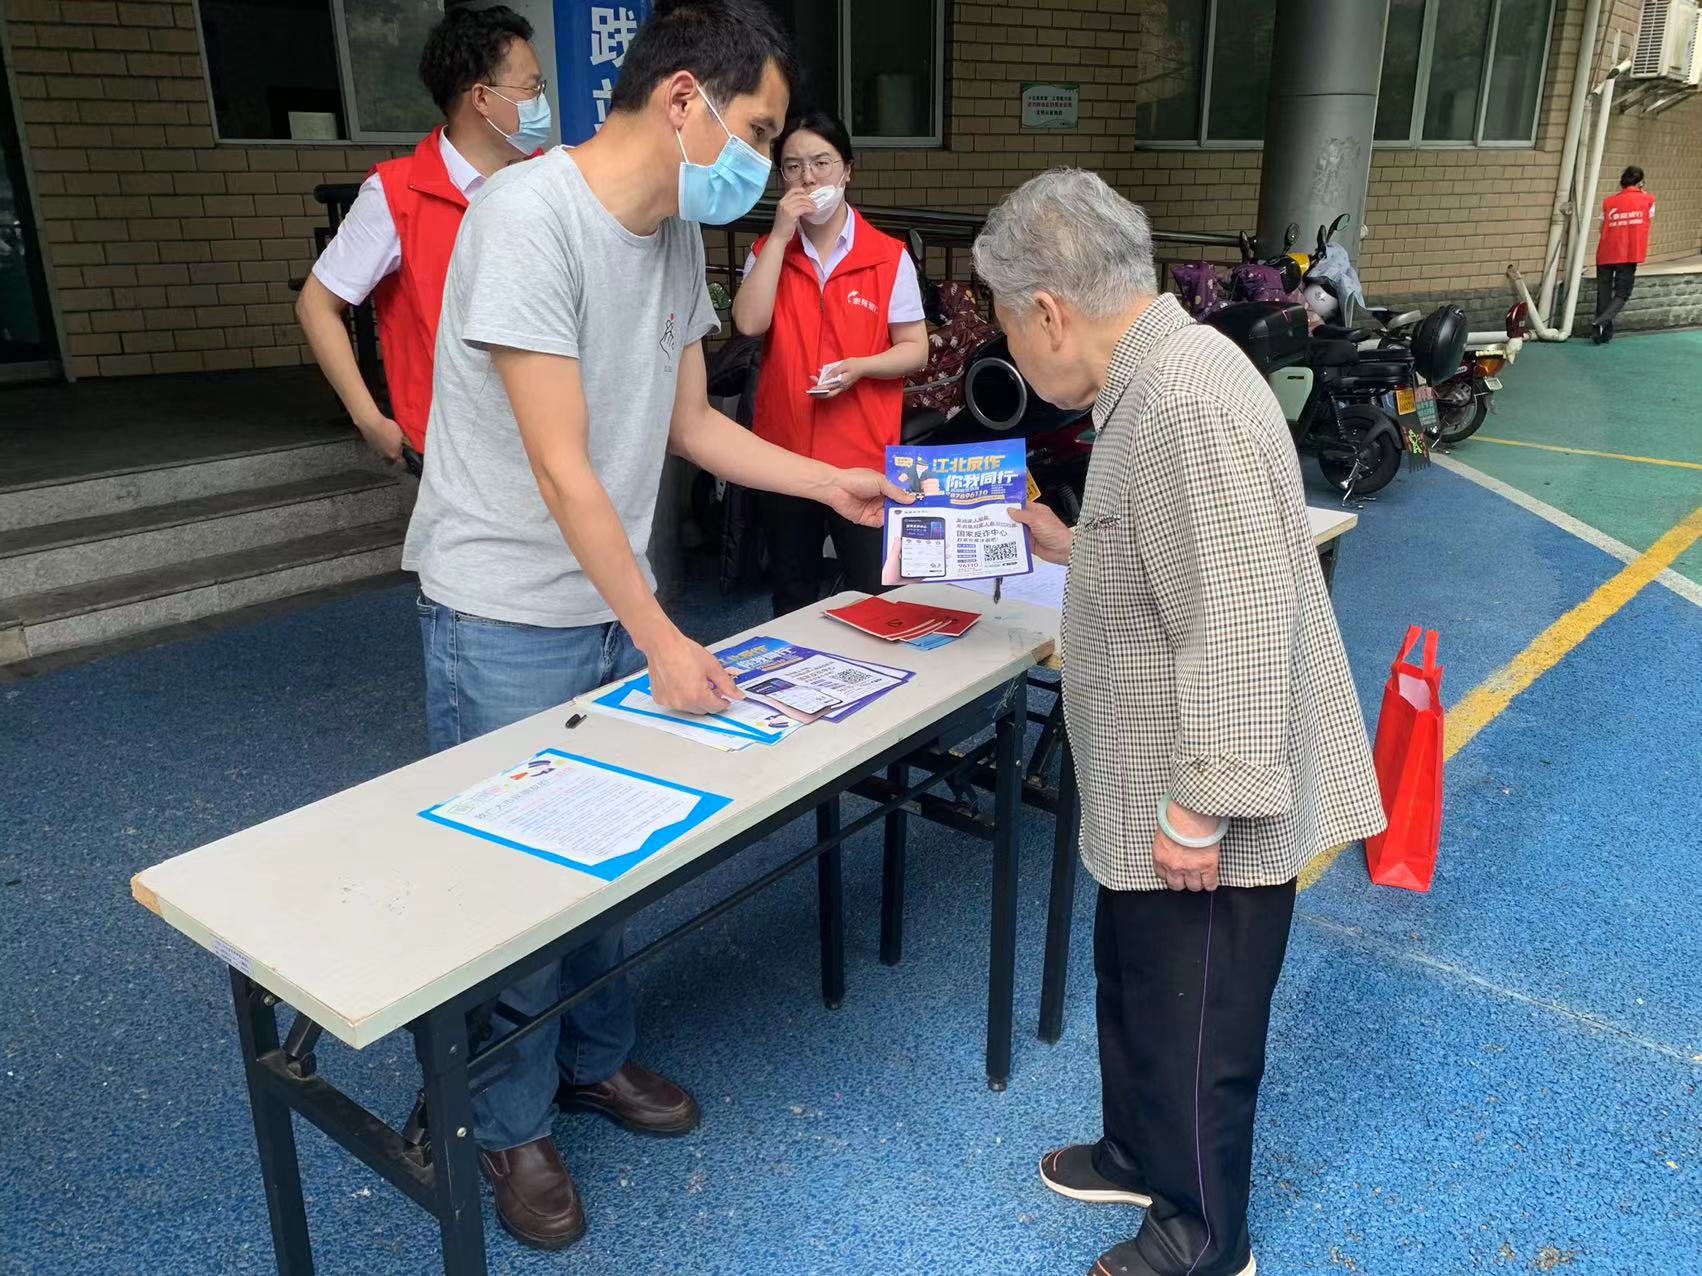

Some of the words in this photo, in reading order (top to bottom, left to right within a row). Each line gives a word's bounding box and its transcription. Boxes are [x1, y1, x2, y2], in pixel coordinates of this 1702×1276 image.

[946, 470, 1018, 491] 你我同行
[956, 529, 1008, 538] 国家反诈中心
